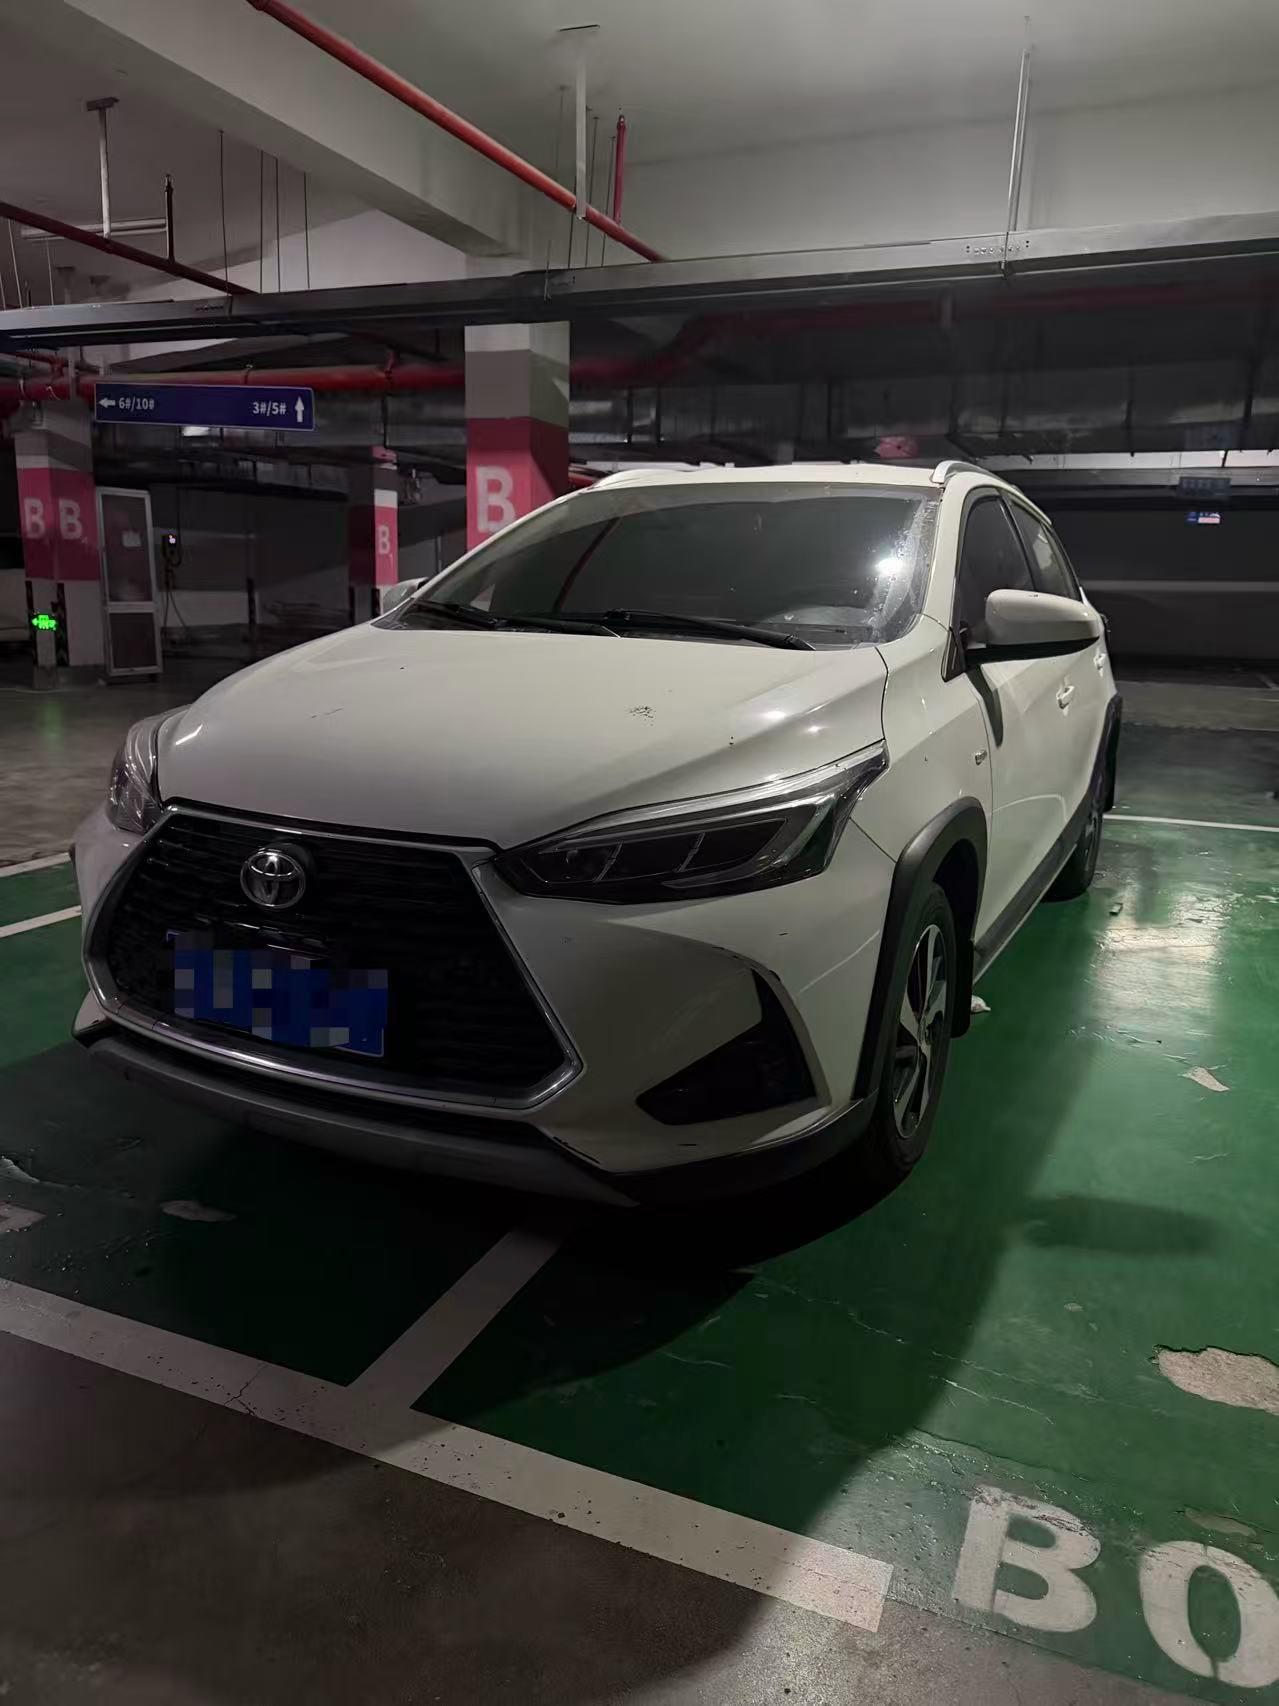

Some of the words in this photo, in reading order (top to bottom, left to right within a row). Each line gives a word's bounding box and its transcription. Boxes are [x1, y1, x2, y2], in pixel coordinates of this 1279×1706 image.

[118, 397, 155, 412] 6#/10#
[253, 401, 287, 416] 3#/5#
[476, 465, 517, 533] B
[24, 498, 46, 539] B
[58, 498, 82, 539] B
[378, 525, 391, 554] B
